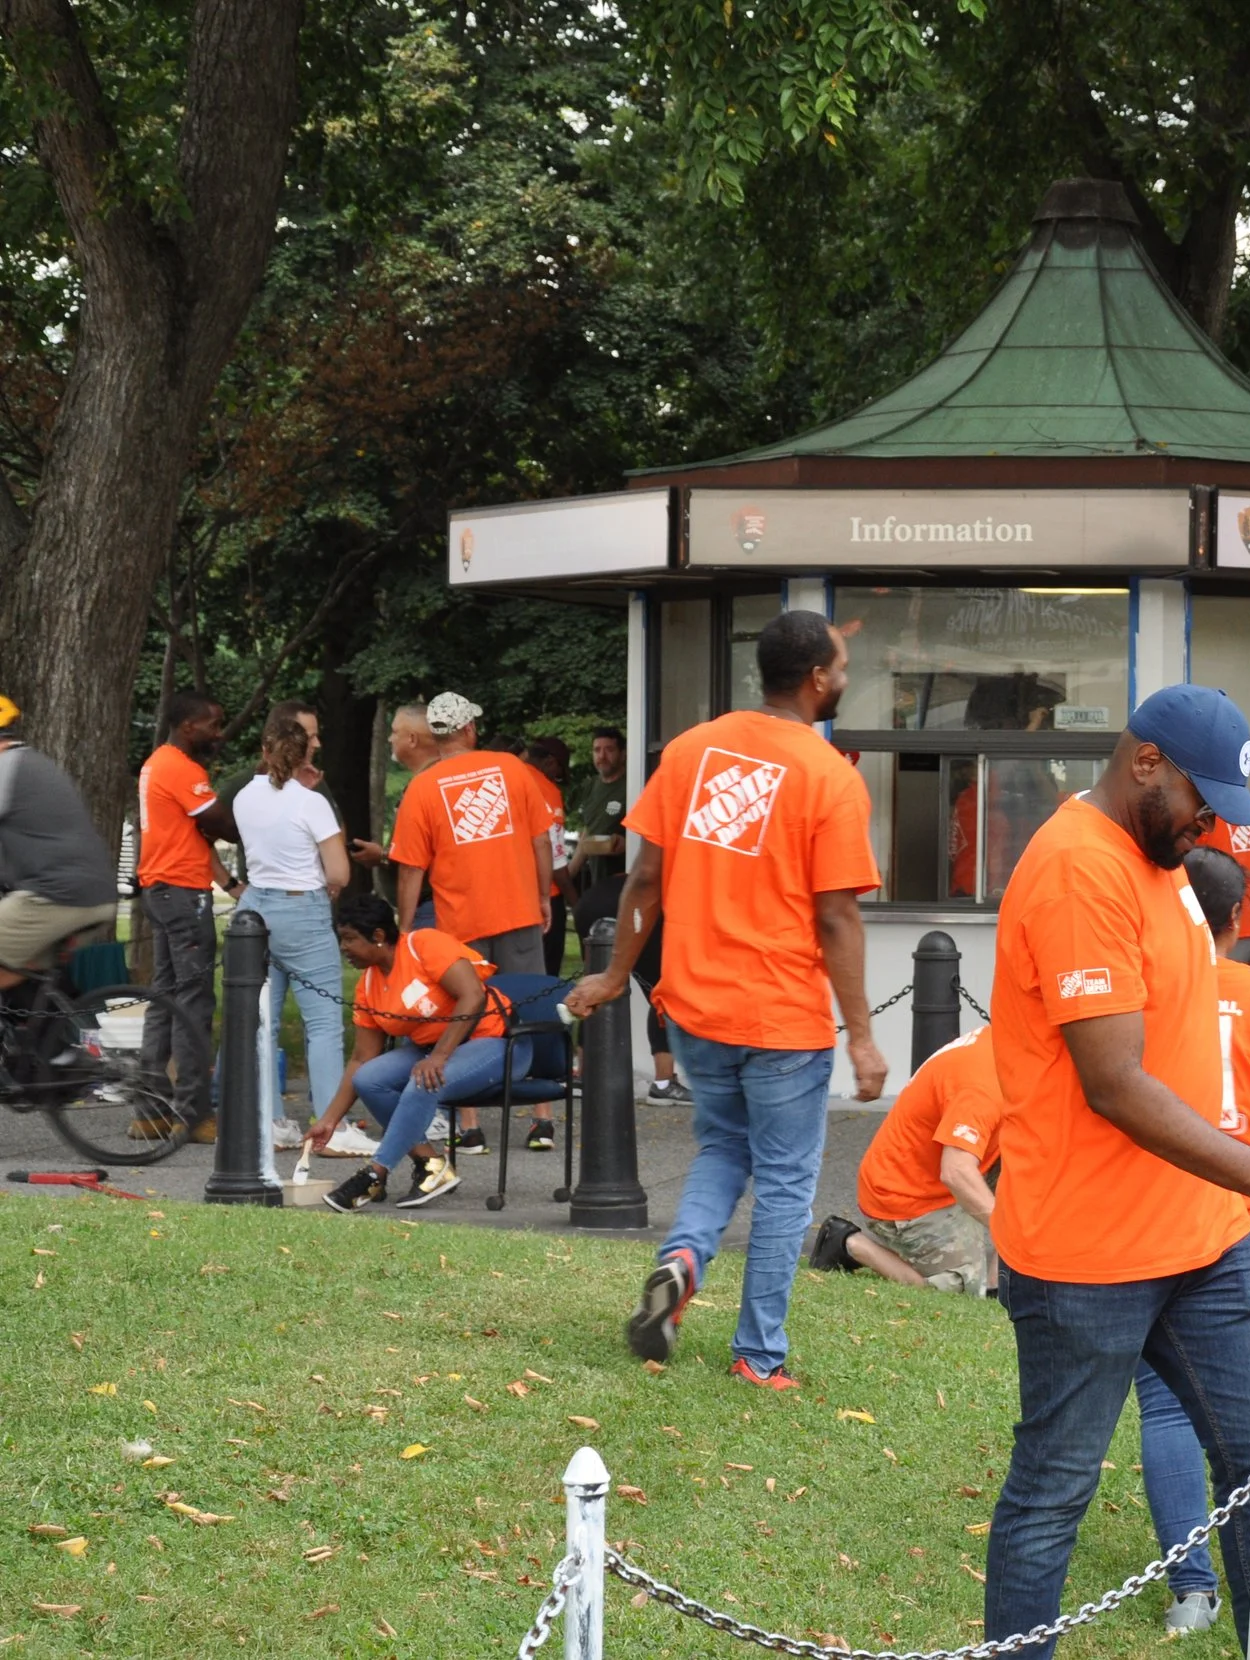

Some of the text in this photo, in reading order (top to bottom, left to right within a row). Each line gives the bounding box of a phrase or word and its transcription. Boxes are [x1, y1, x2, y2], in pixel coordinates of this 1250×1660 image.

[850, 517, 1033, 543] Information
[453, 787, 476, 812] THE
[689, 764, 779, 839] HOME
[703, 765, 741, 796] THE
[455, 776, 504, 840] HOME
[477, 796, 508, 838] DEPOT
[715, 797, 769, 845] DEPOT
